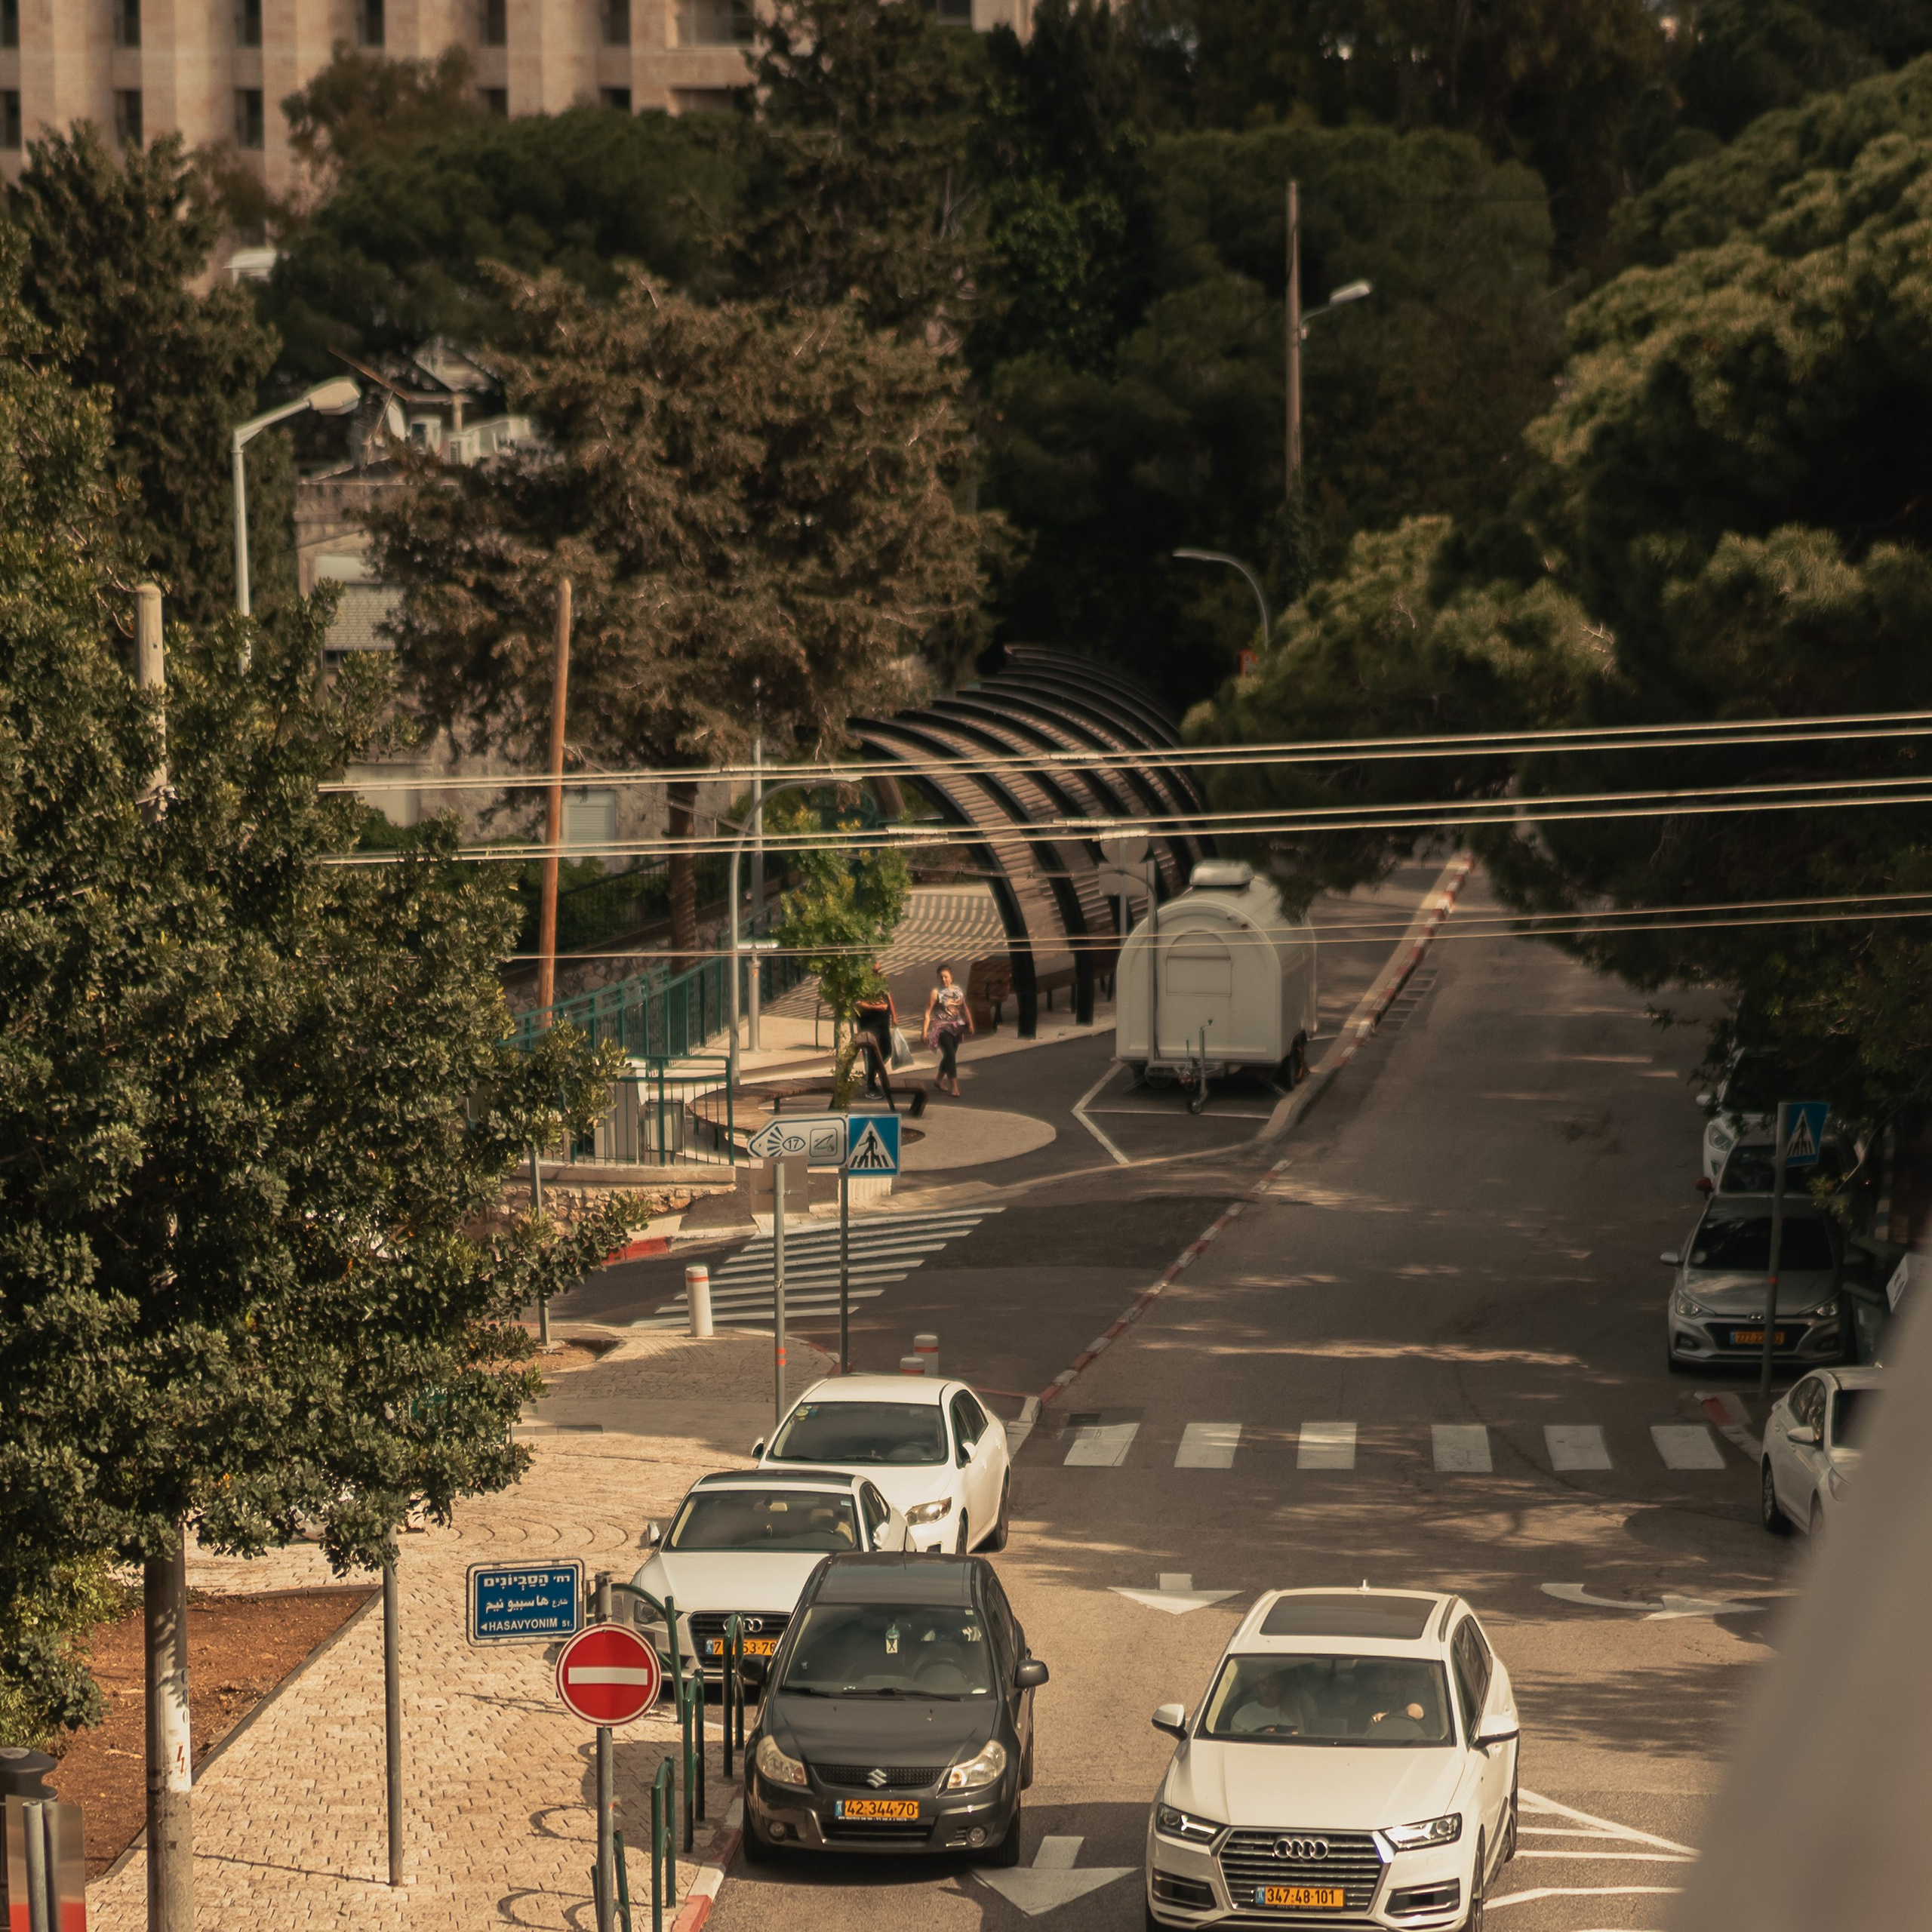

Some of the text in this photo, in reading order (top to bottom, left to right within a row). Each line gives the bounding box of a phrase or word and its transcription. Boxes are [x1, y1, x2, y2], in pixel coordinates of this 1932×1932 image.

[788, 1139, 800, 1149] 17
[552, 1598, 568, 1607] شارع
[488, 1617, 558, 1632] HASAVYONIM
